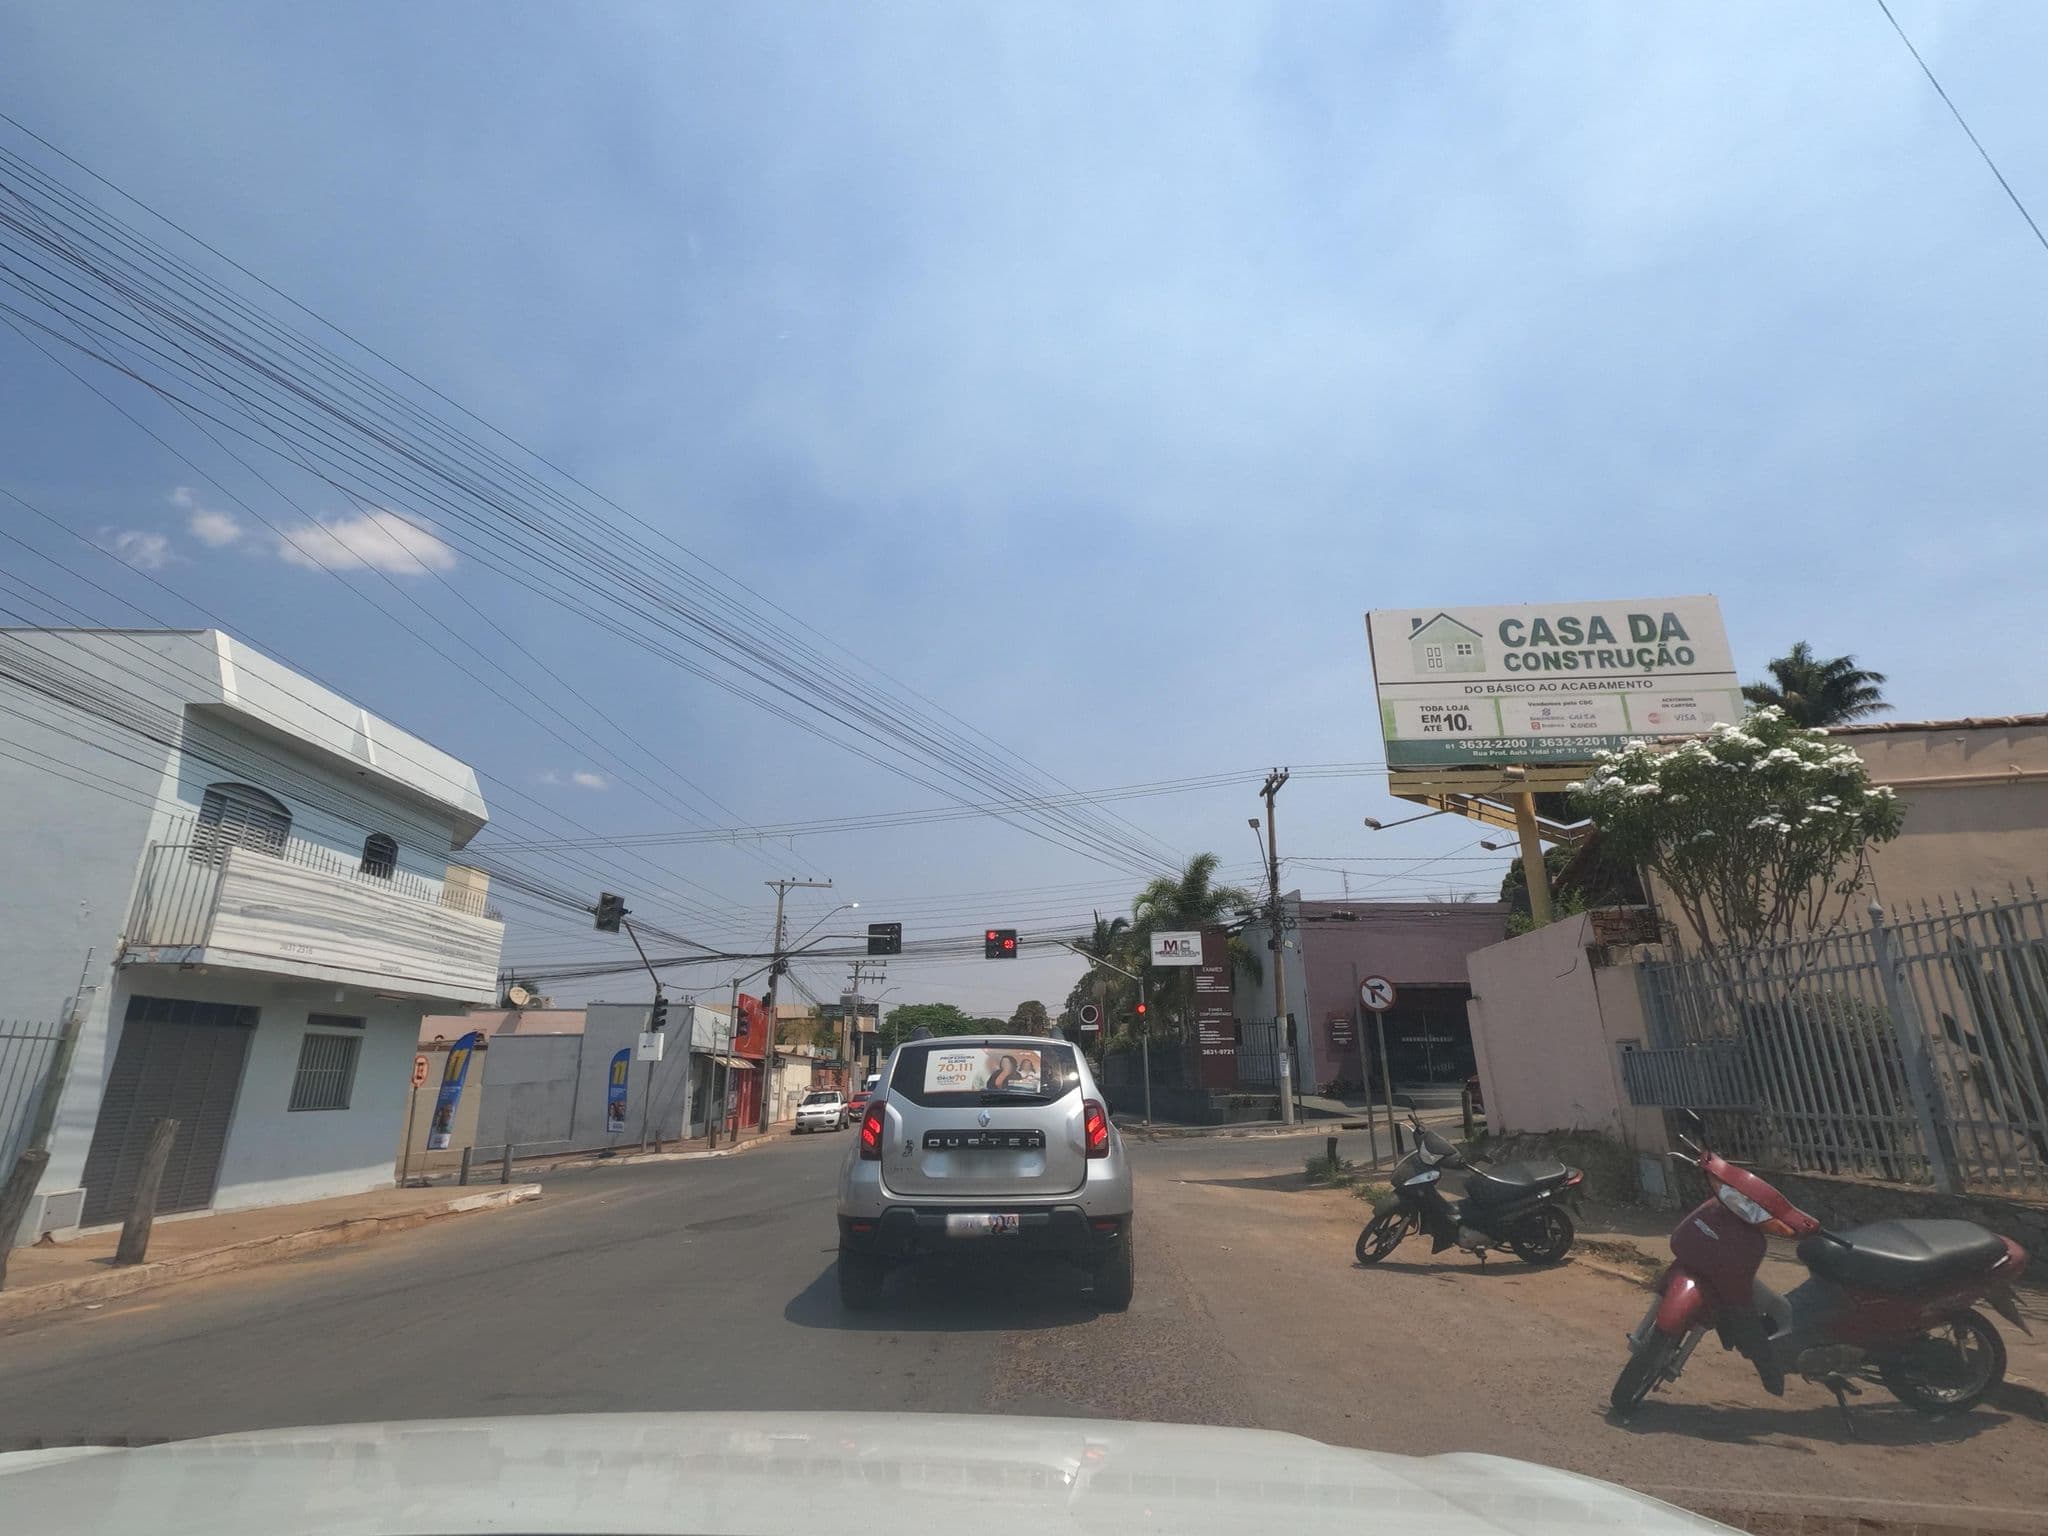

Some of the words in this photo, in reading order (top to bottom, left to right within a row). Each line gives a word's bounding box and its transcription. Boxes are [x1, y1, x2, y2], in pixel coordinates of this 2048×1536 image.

[1498, 615, 1618, 648] CASA
[1627, 612, 1690, 644] DA
[1503, 643, 1696, 673] CONSTRUÇÃO
[1464, 685, 1483, 694] DO
[1486, 682, 1536, 694] BÁSICO
[1539, 683, 1557, 692] AO
[1561, 680, 1654, 691] ACABAMENTO
[1421, 714, 1442, 724] EM
[1674, 713, 1697, 721] VISA
[1423, 723, 1443, 732] ATÉ
[1459, 738, 1528, 750] 3632-2200
[1539, 736, 1608, 748] 3632-2201
